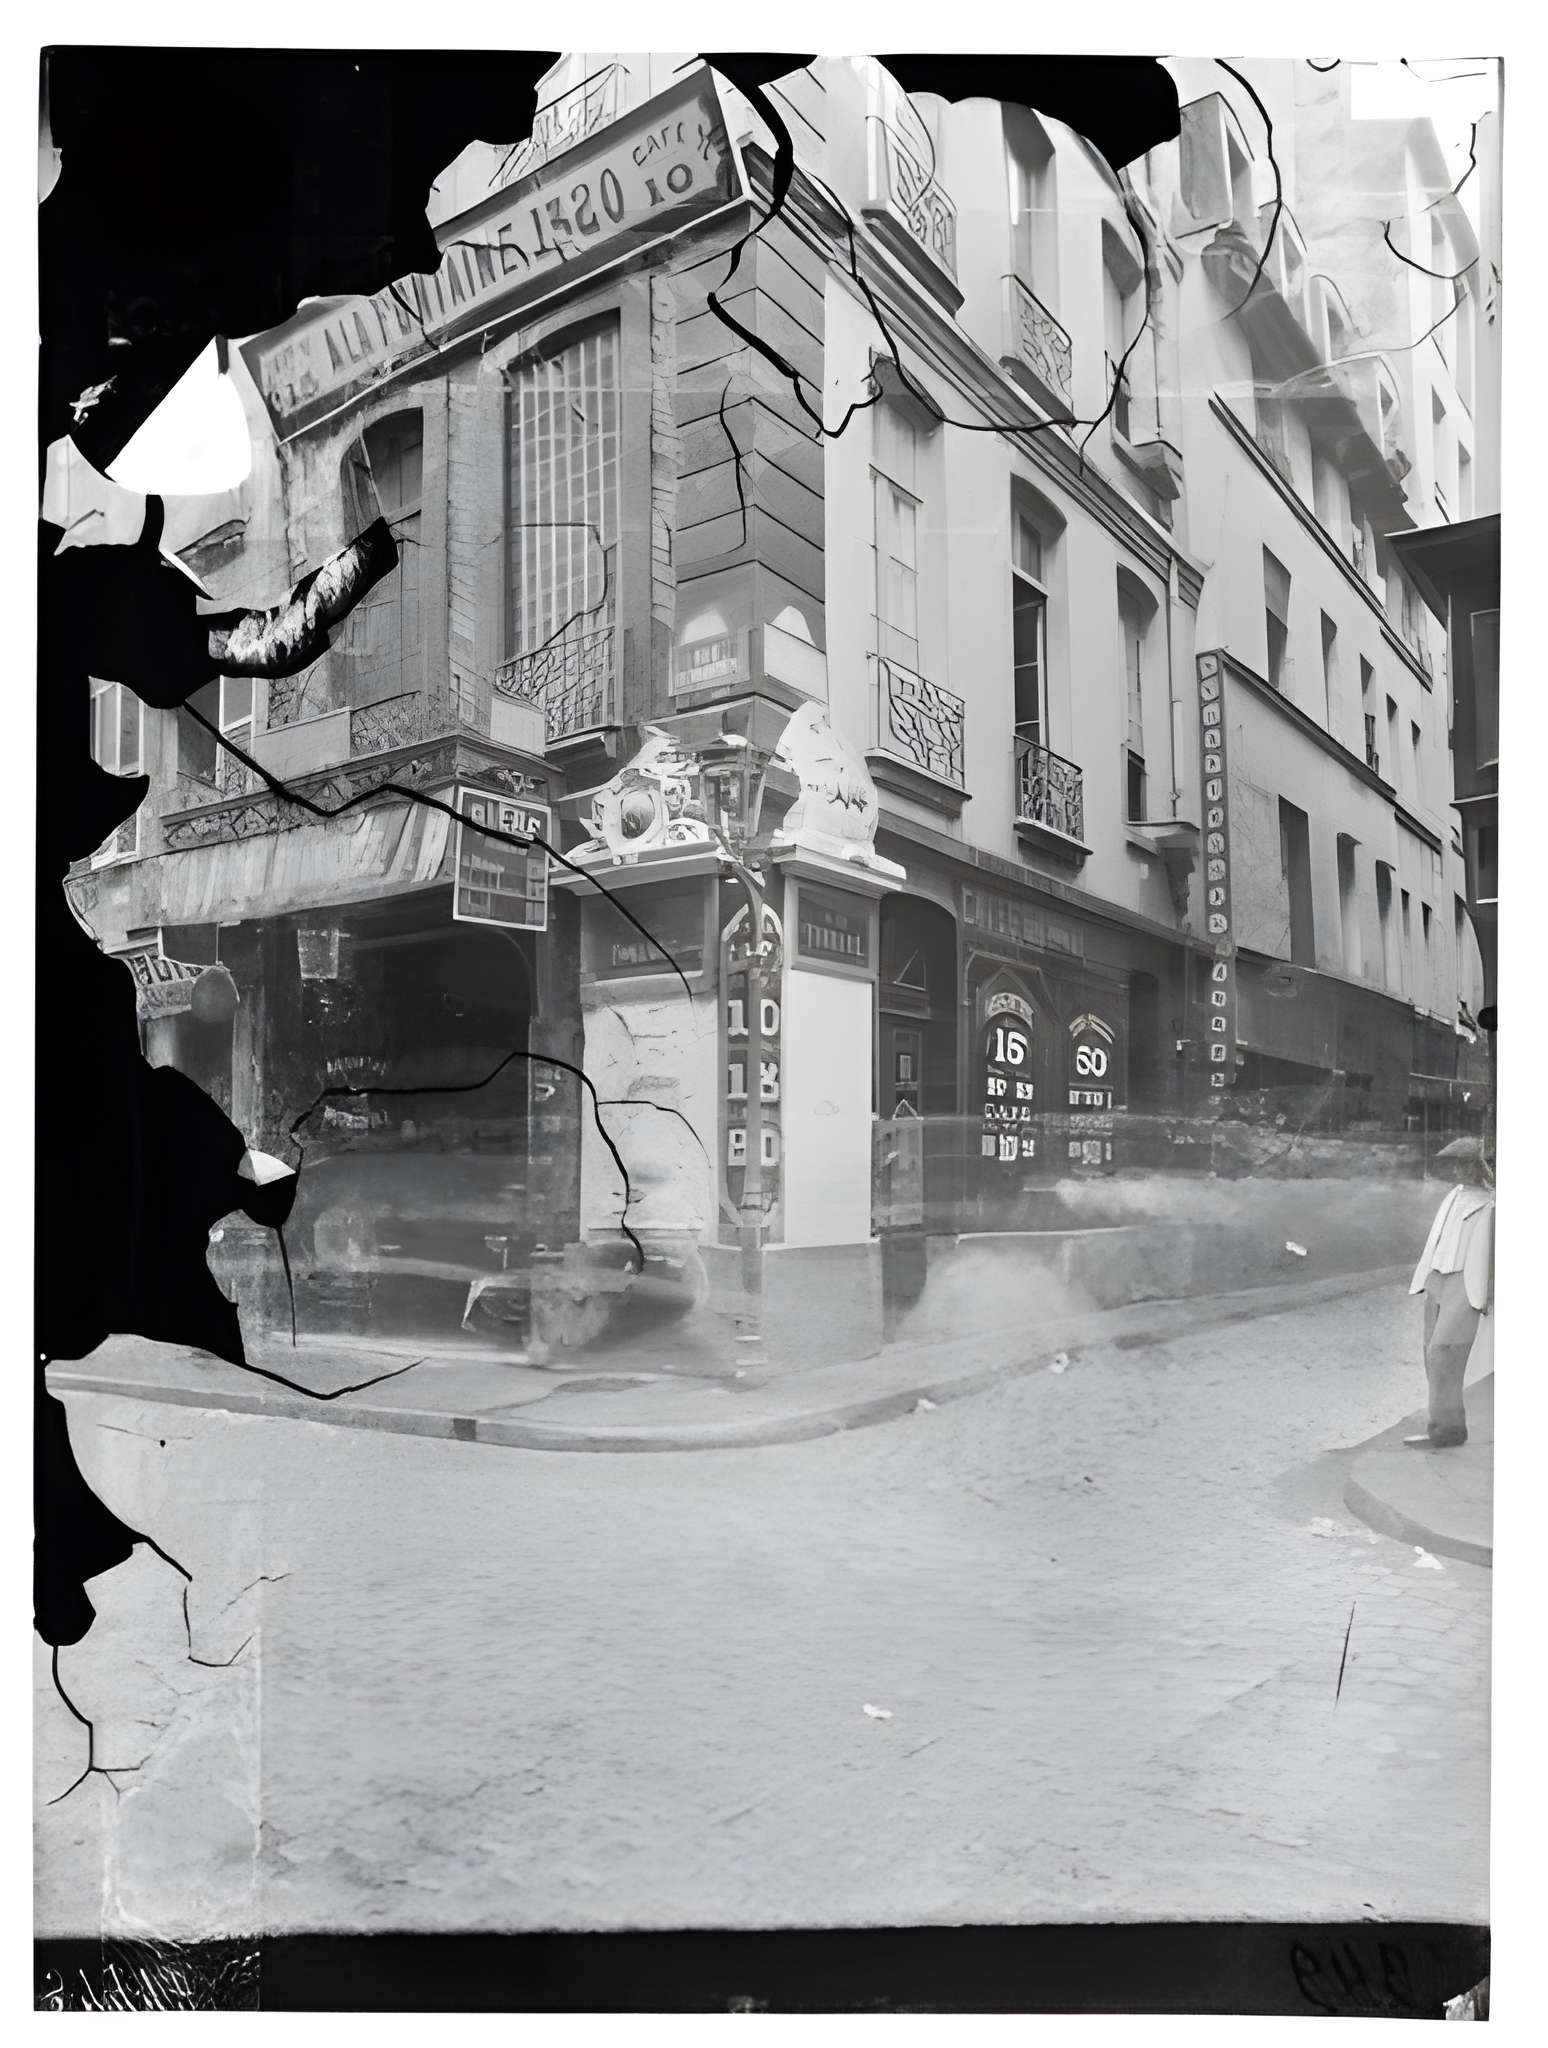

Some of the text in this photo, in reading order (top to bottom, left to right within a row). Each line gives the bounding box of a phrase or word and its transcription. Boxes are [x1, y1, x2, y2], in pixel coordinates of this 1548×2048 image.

[644, 163, 694, 208] 10
[994, 1027, 1029, 1065] 16
[1076, 1045, 1108, 1078] 60
